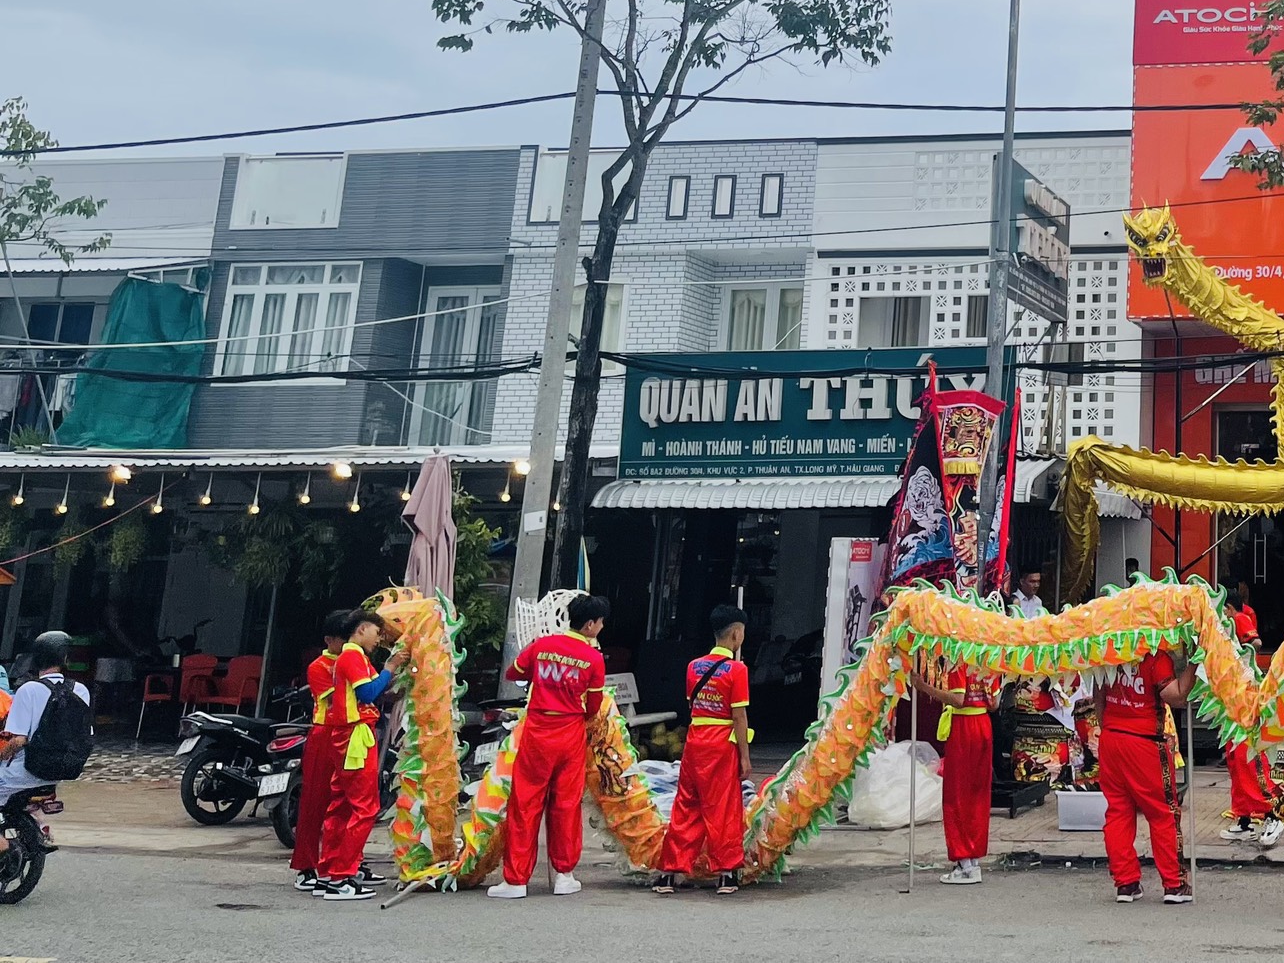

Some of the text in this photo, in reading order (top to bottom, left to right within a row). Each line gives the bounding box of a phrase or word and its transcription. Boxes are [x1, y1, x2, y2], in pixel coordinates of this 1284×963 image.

[642, 439, 655, 456] MÌ
[666, 438, 702, 456] HOÀNH
[706, 437, 742, 455] THÁNH
[752, 435, 766, 455] HỦ
[770, 435, 794, 454] TIẾU
[797, 439, 823, 455] NAM
[827, 438, 856, 454] VANG
[867, 433, 896, 453] MIẾN
